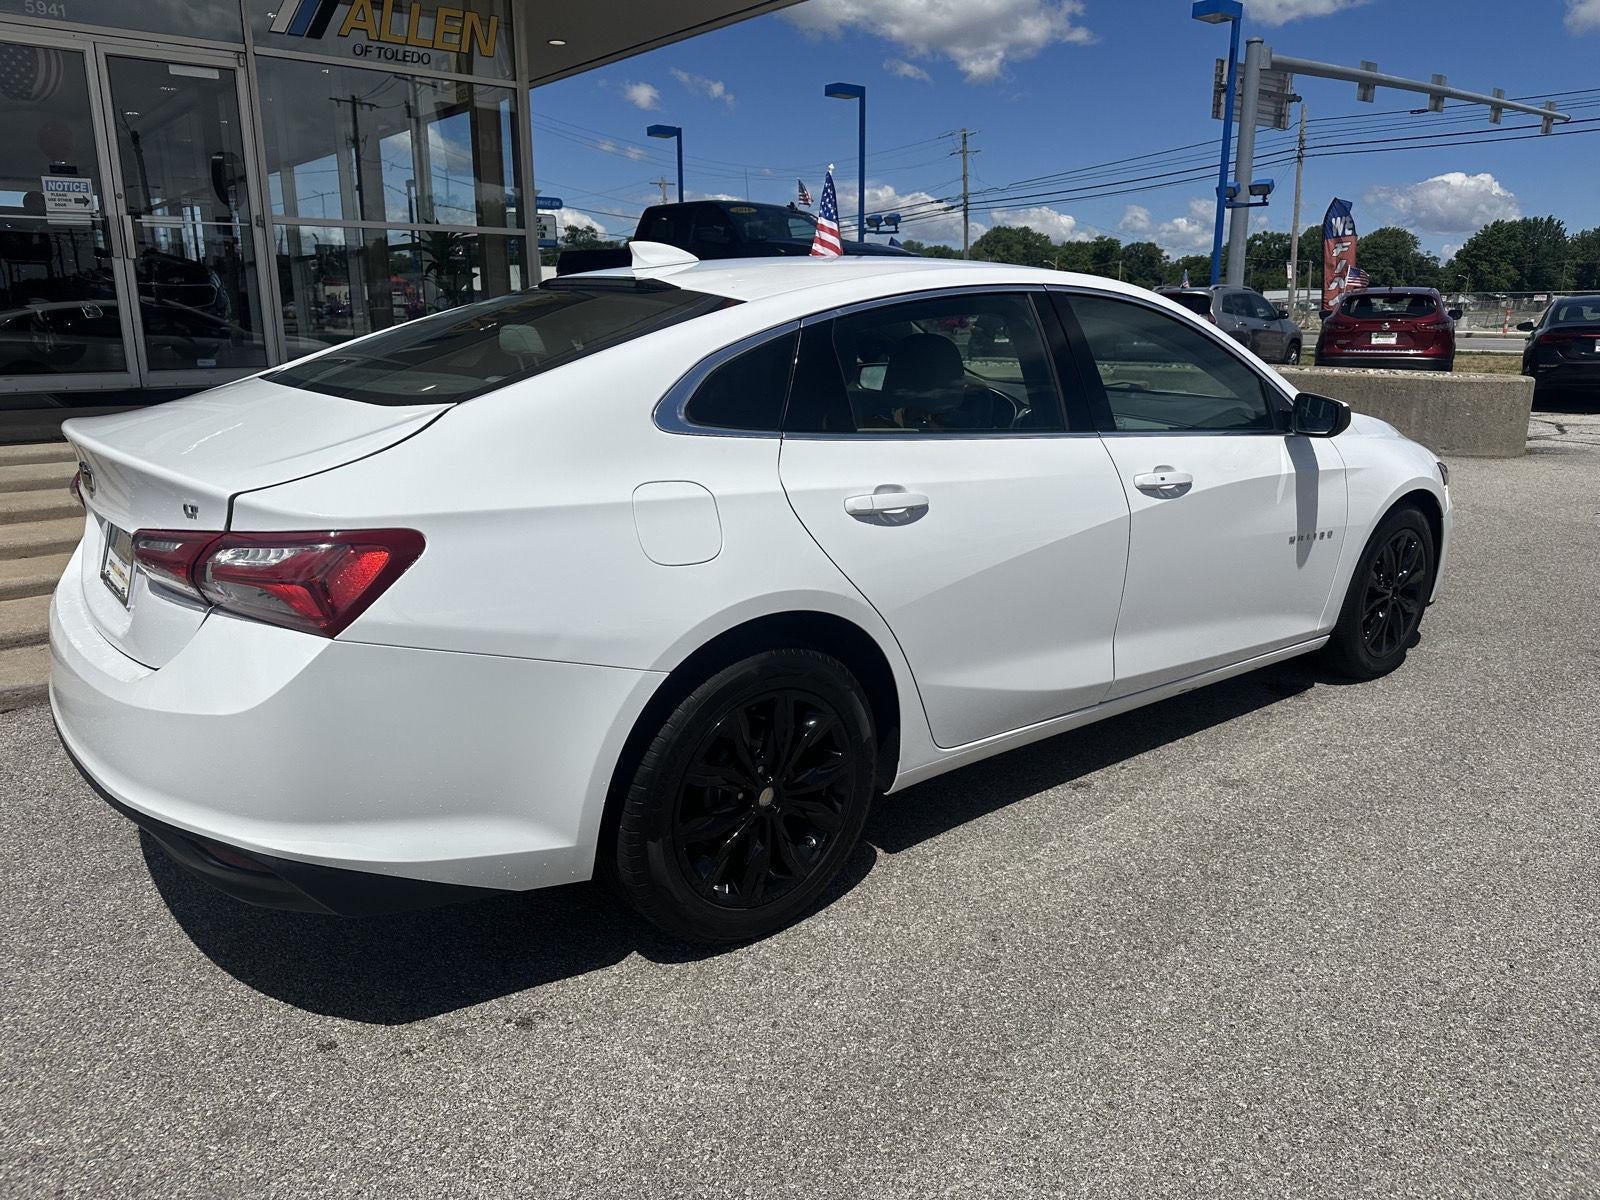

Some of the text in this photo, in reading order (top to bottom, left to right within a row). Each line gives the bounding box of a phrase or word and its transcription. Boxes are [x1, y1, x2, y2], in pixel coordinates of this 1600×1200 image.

[24, 0, 66, 17] 5941
[337, 0, 498, 57] ALLEN
[352, 43, 431, 65] OF TOLEDO
[48, 181, 87, 191] NOTICE
[1331, 216, 1353, 236] WE
[182, 503, 199, 520] LT
